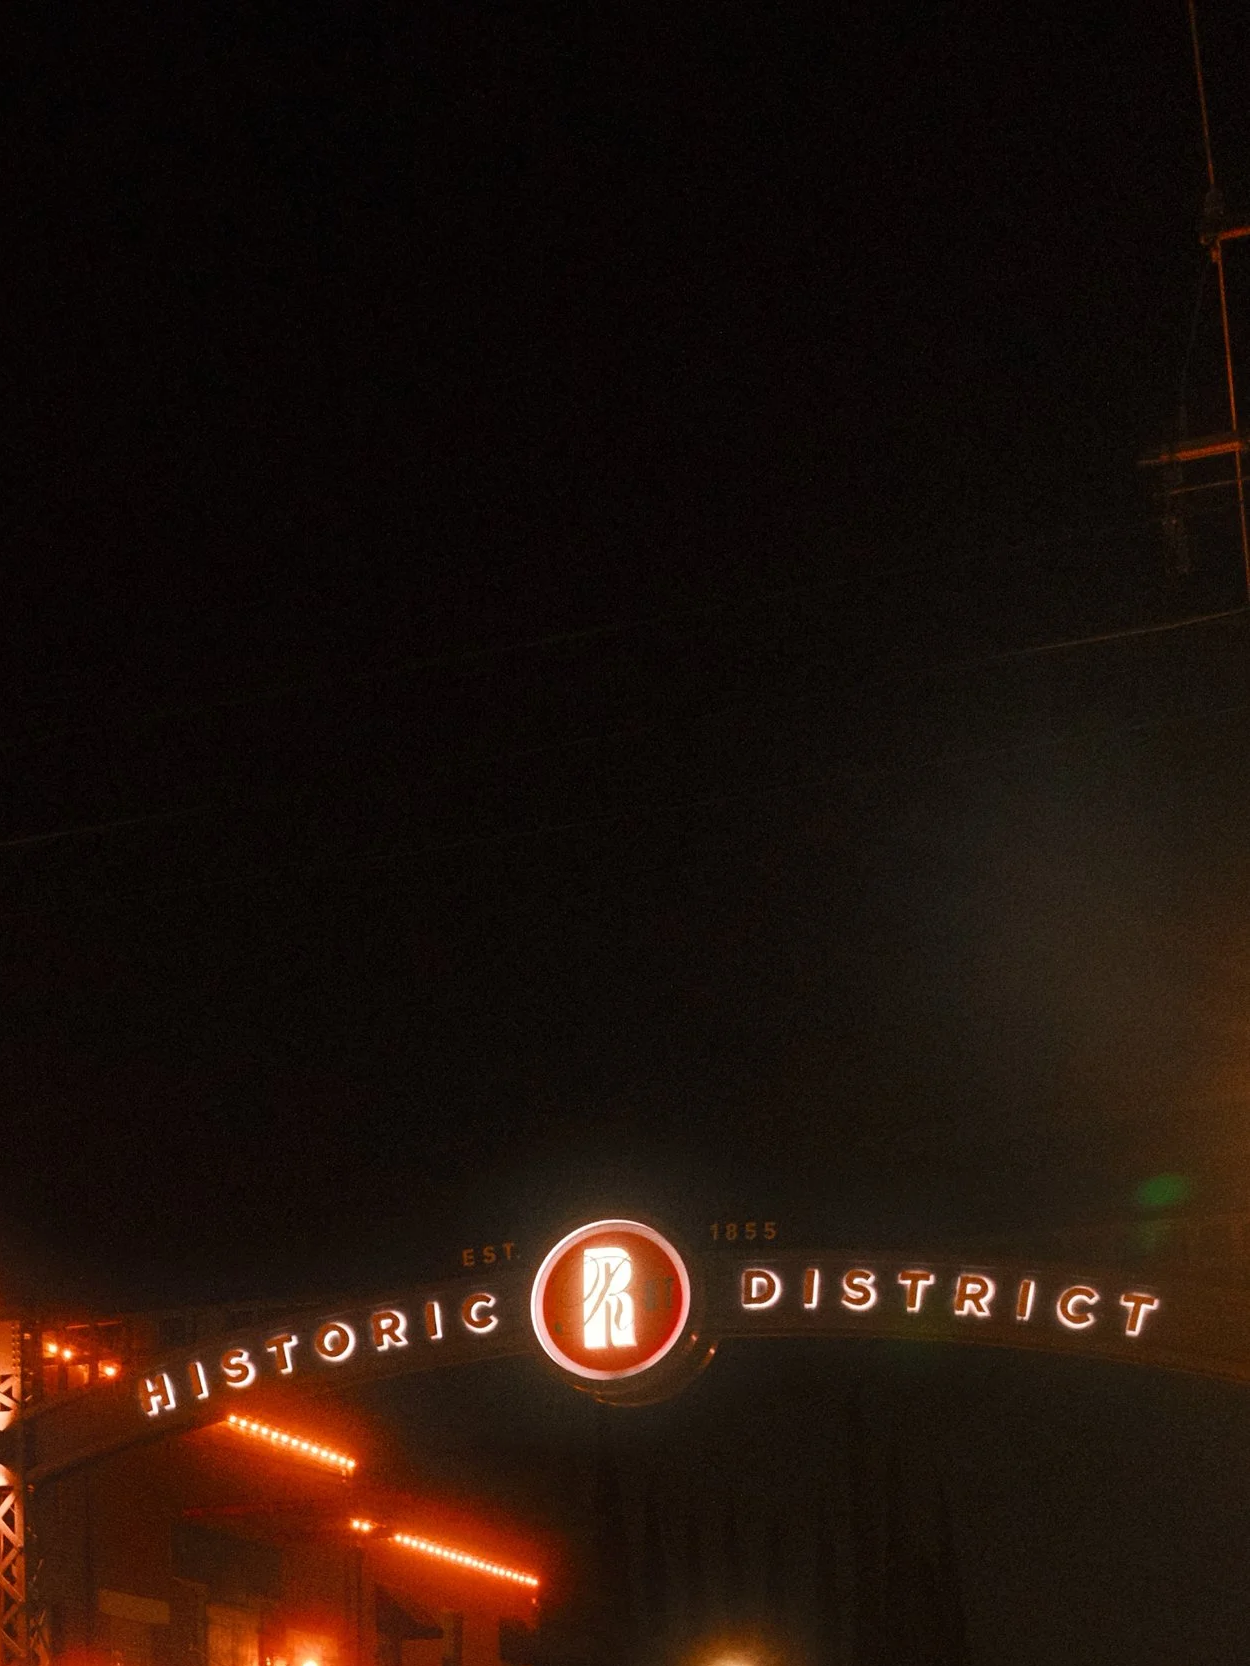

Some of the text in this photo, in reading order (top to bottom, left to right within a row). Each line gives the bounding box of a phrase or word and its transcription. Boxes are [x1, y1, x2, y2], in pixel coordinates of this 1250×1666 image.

[709, 1221, 778, 1241] 1855
[141, 1268, 1158, 1415] HISTORIC DISTRICT
